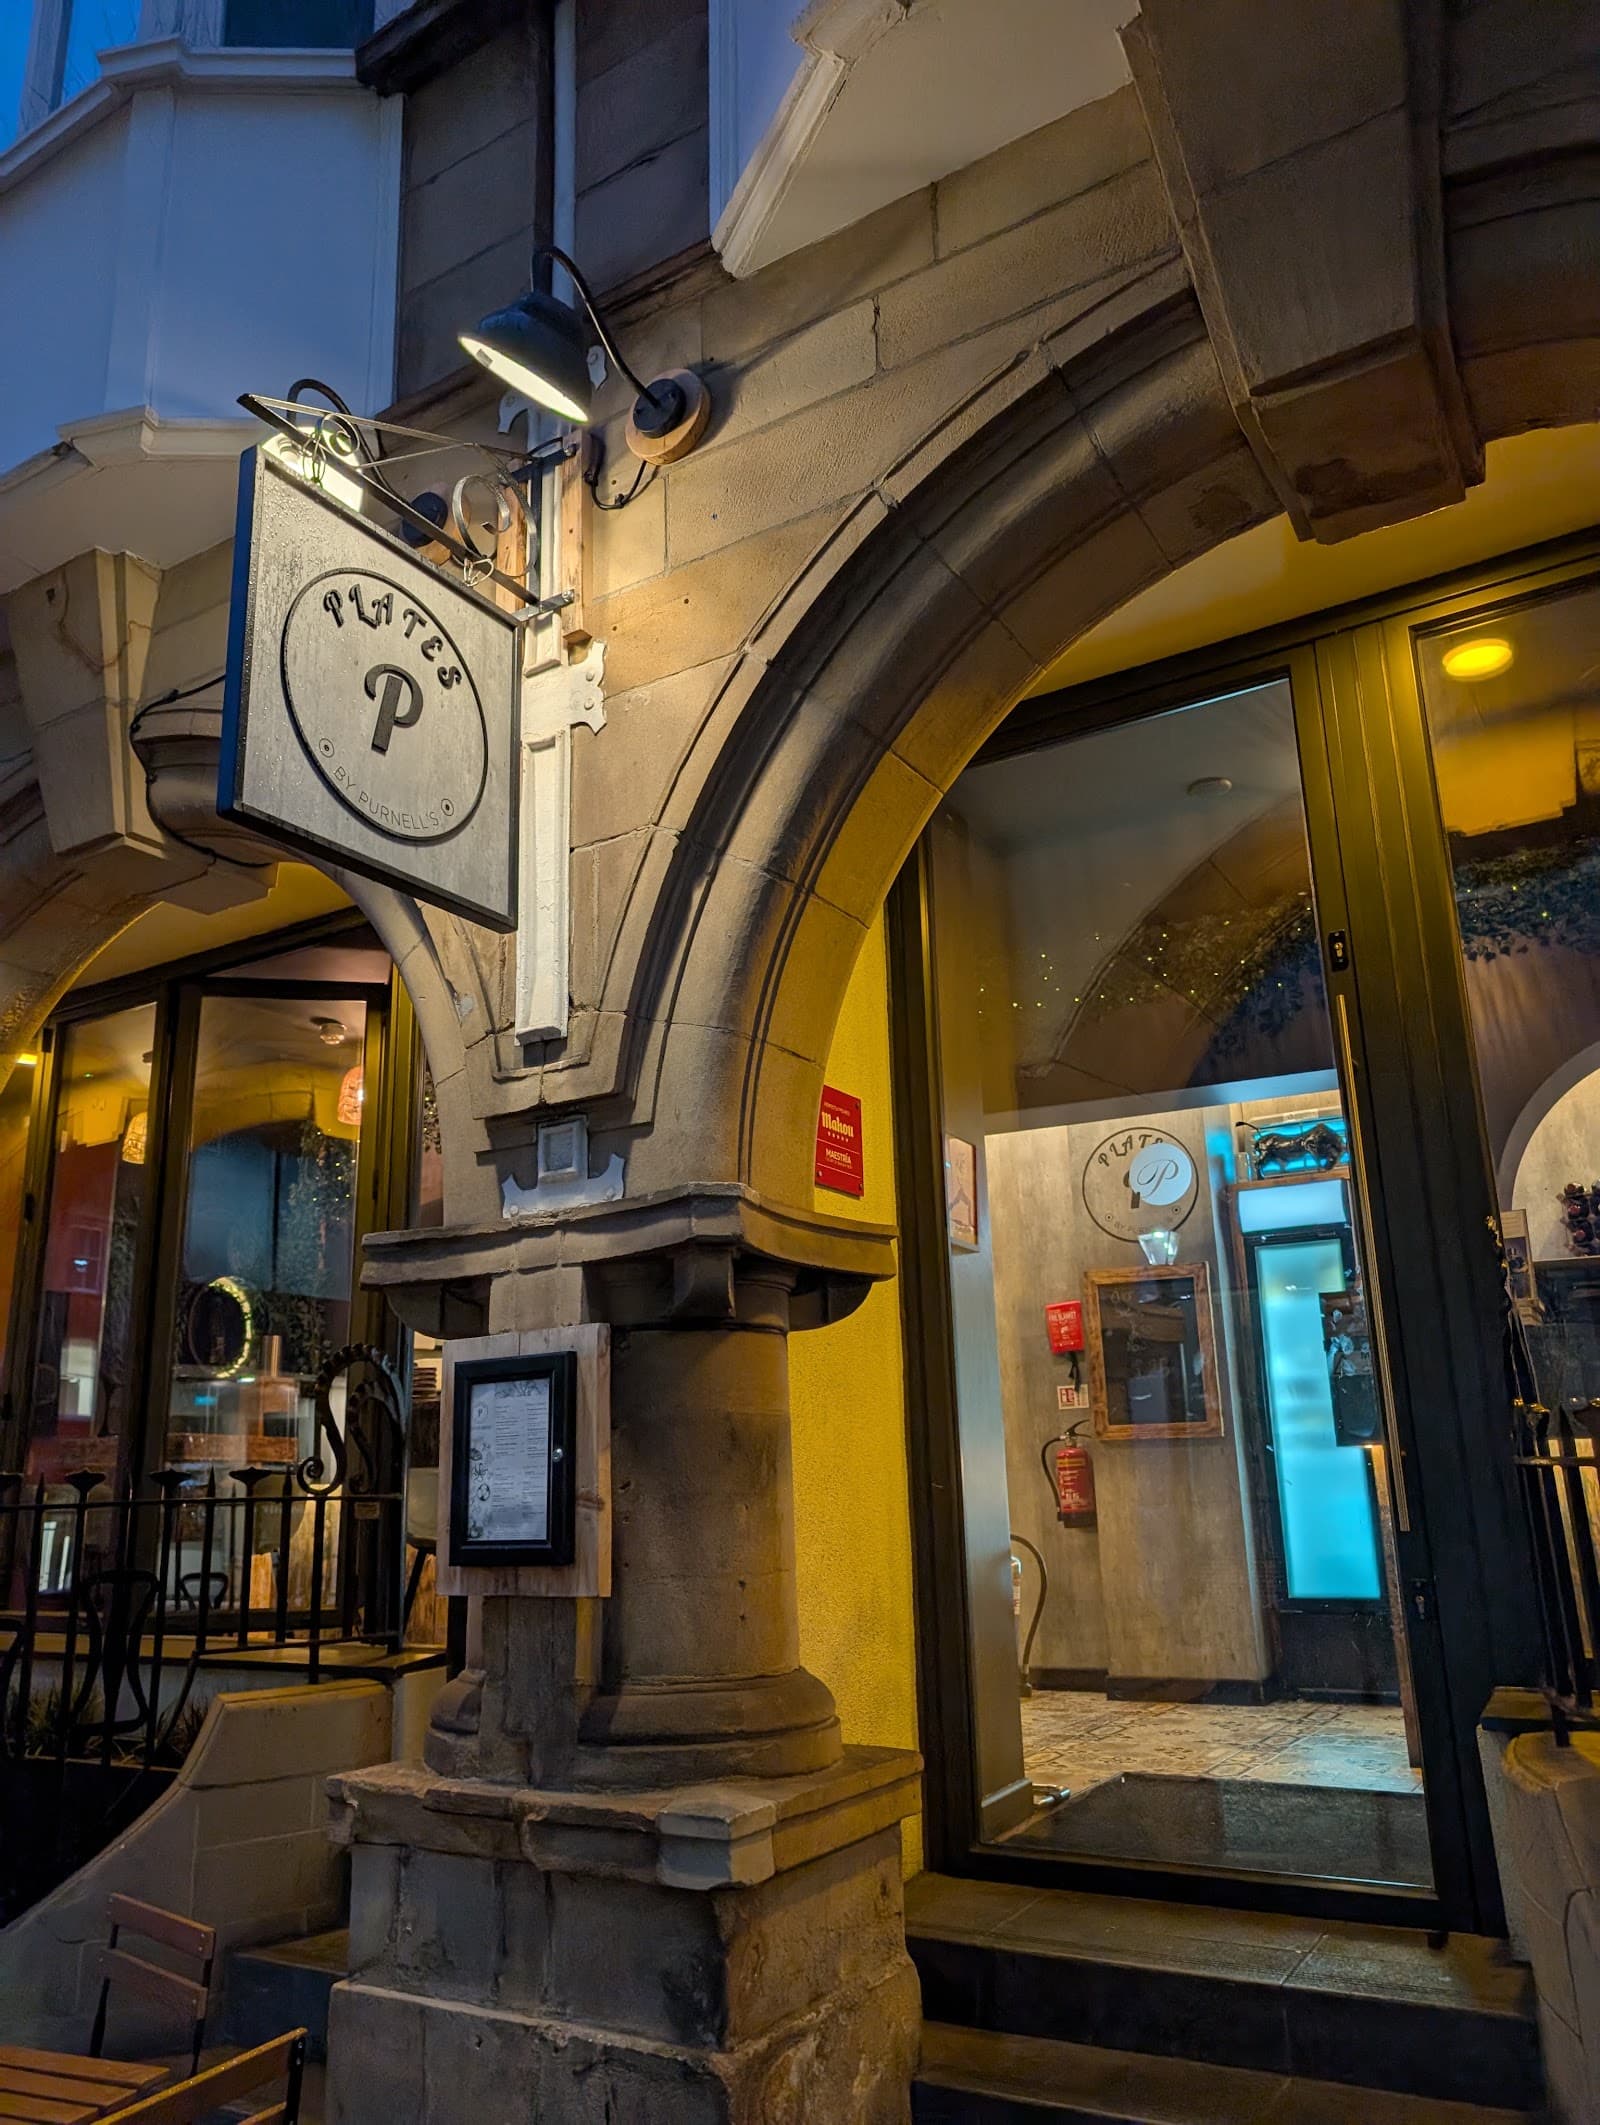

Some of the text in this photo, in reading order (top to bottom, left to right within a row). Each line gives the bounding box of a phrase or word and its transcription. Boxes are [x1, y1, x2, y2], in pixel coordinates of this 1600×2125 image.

[322, 583, 463, 690] PLATES
[364, 663, 424, 756] P
[333, 766, 439, 830] BY PURNELL'S
[821, 1111, 854, 1138] Mahou
